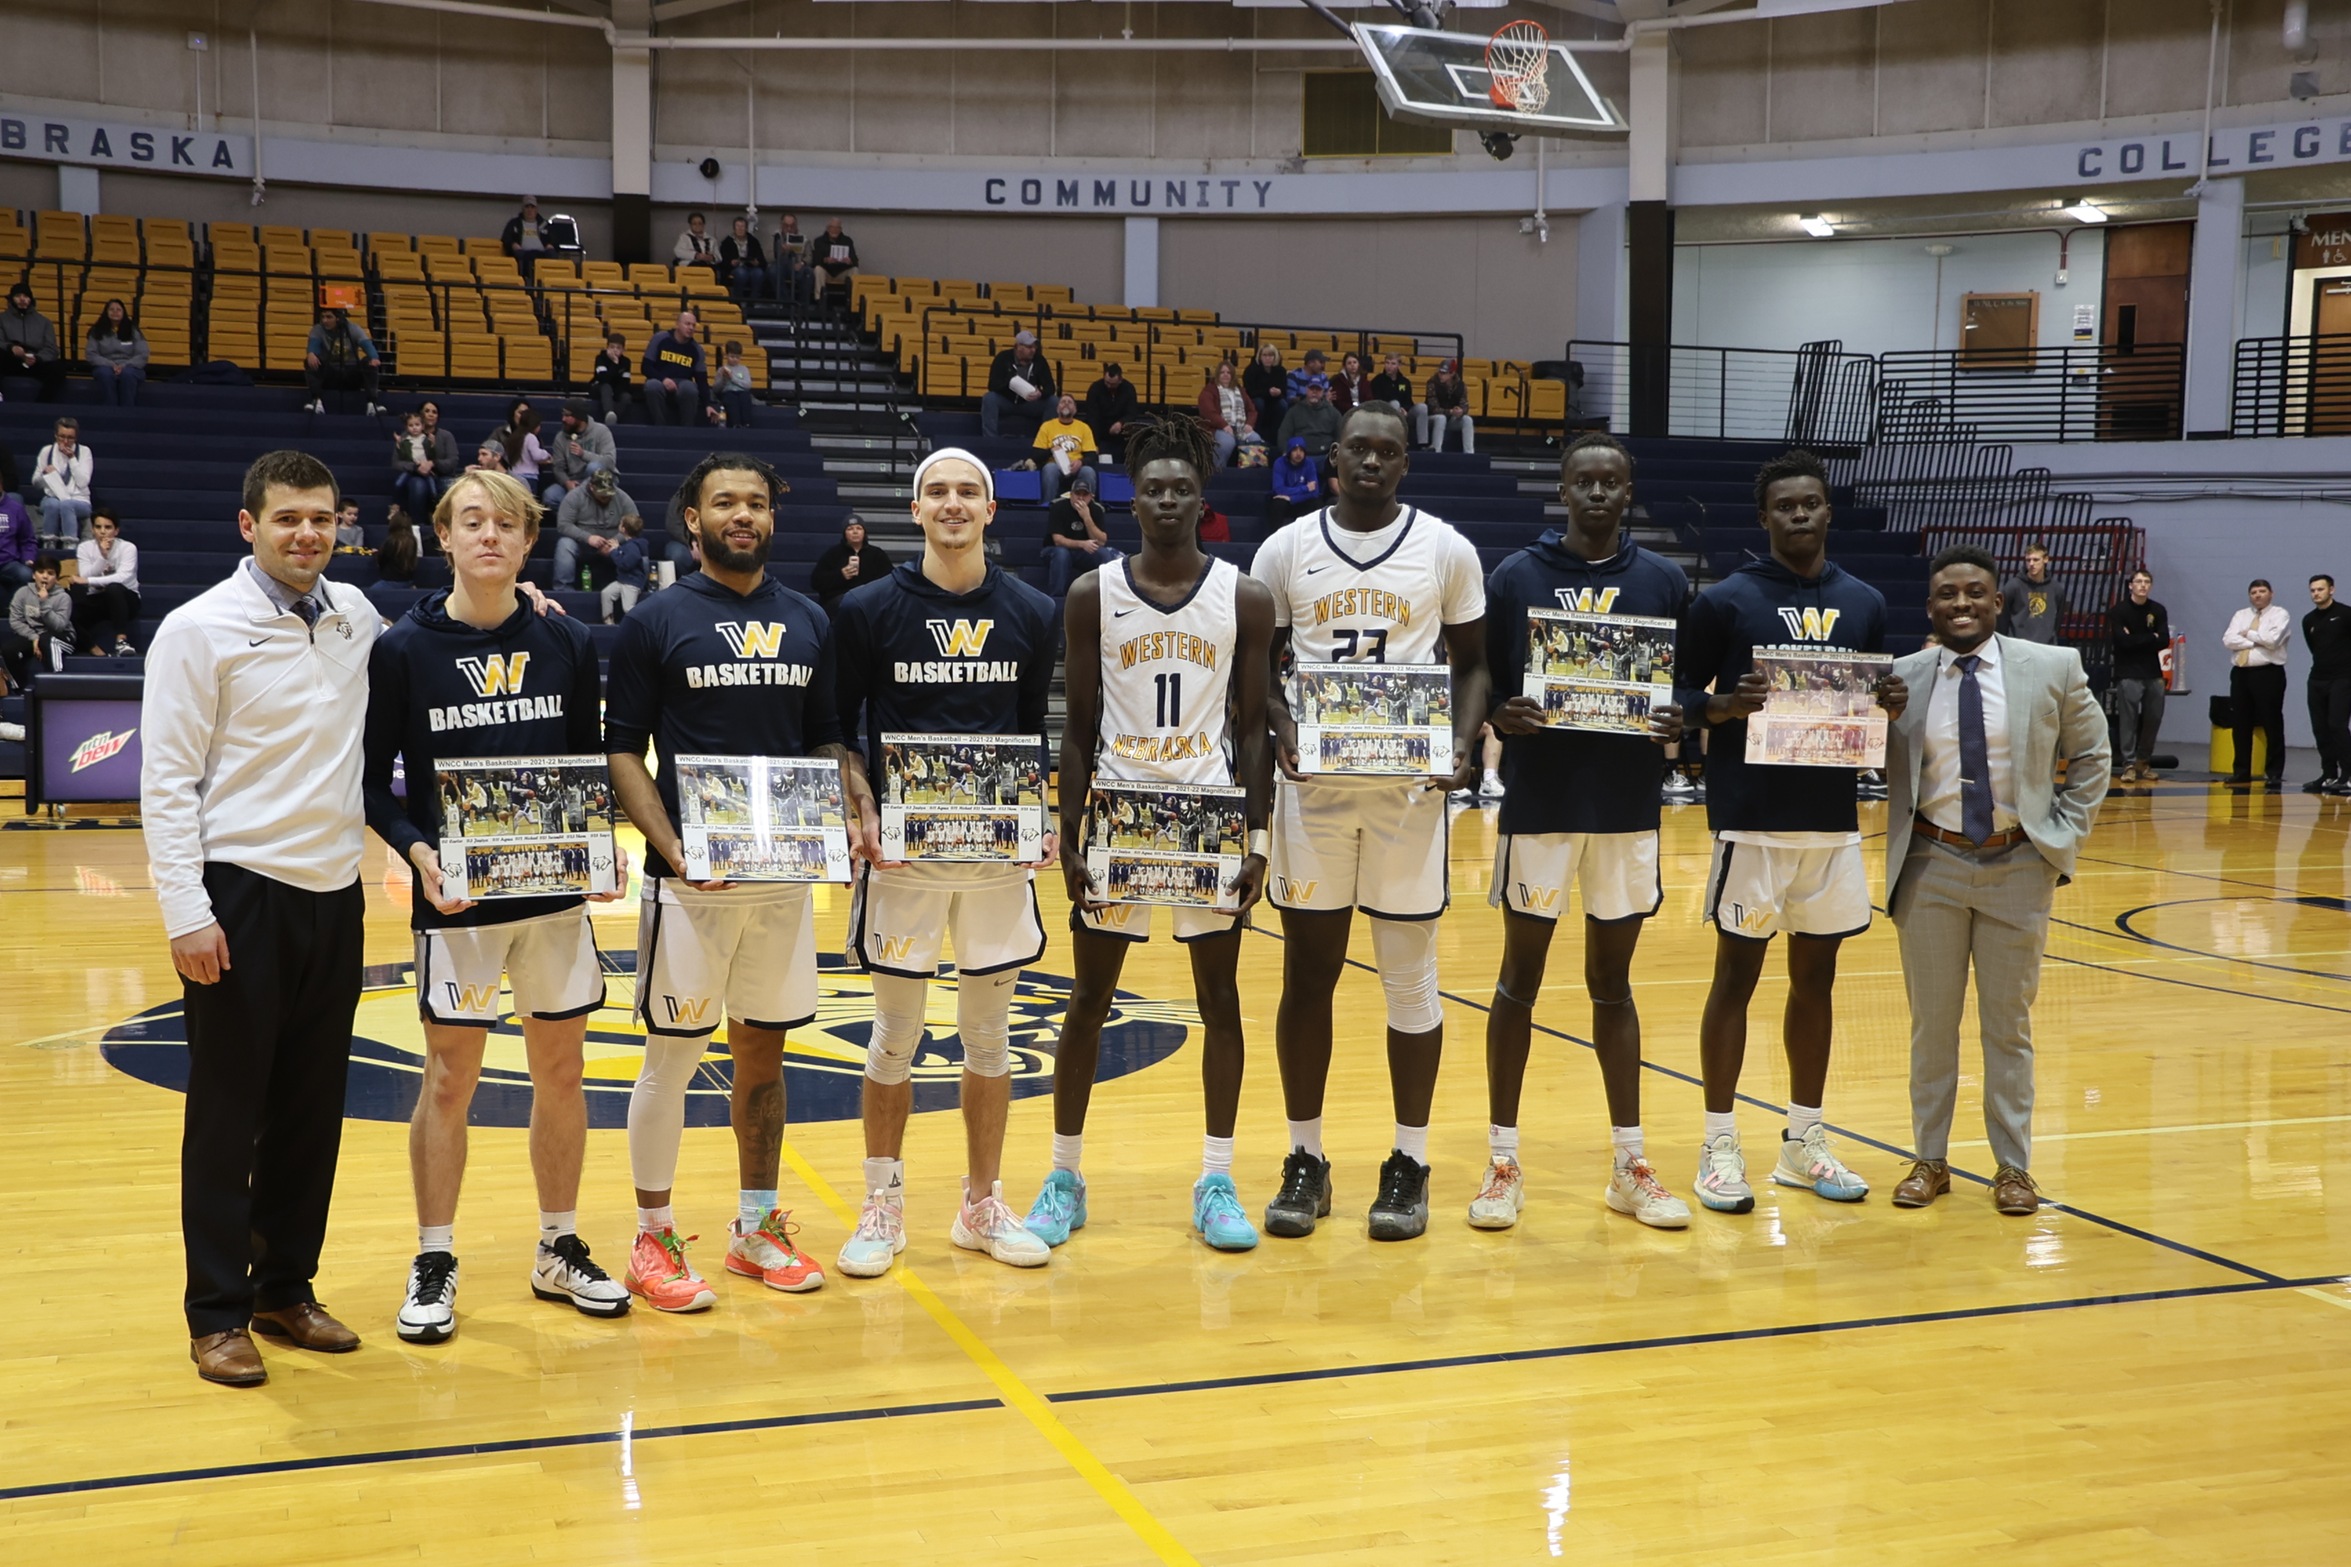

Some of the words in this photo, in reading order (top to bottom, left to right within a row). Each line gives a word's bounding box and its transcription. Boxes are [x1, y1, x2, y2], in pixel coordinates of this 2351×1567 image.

[1, 119, 234, 169] BRASKA
[985, 178, 1272, 207] COMMUNITY
[1314, 588, 1410, 627] WESTERN
[1119, 631, 1216, 672] WESTERN
[1331, 629, 1388, 662] 23
[894, 661, 1018, 683] BASKETBALL
[428, 694, 563, 732] BASKETBALL
[1154, 672, 1181, 728] 11
[558, 757, 596, 765] Magnificent
[1110, 731, 1213, 761] NEBRASKA
